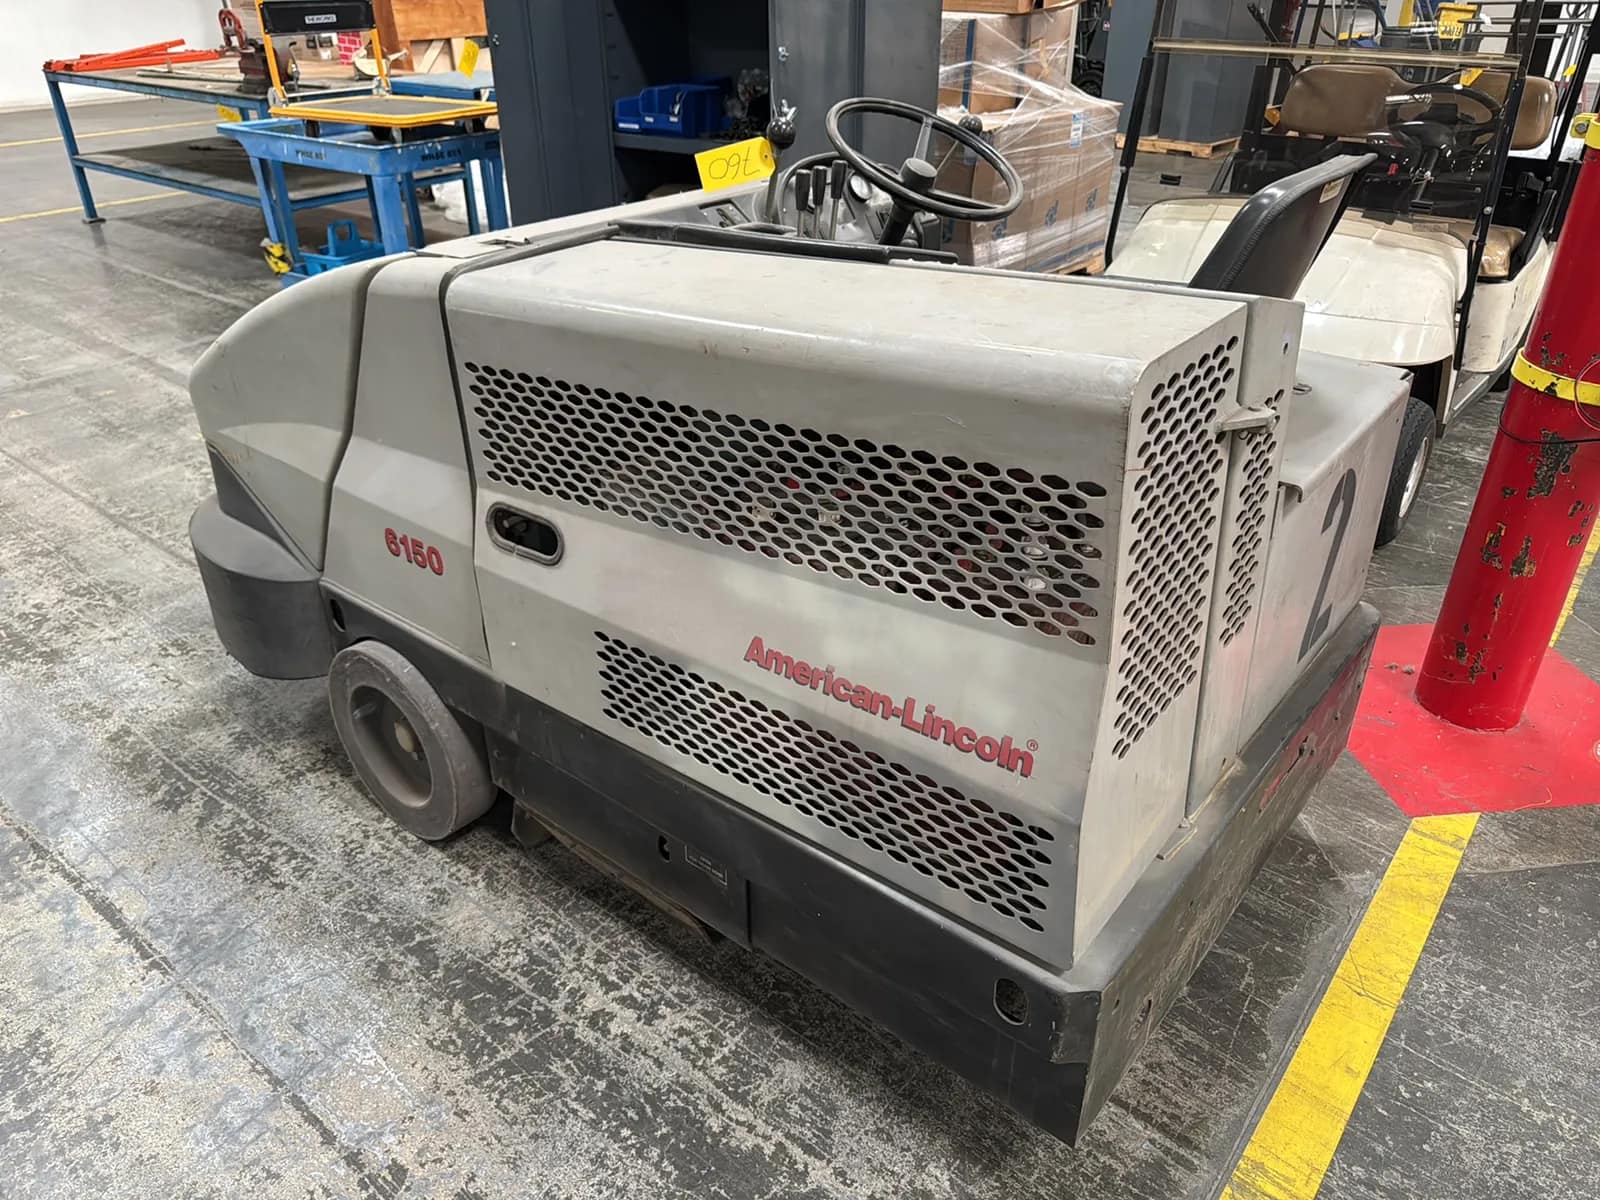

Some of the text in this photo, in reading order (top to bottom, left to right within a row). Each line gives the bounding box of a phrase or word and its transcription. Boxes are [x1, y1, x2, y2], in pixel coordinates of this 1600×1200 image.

[709, 146, 760, 180] 760
[384, 527, 444, 576] 6150
[1297, 468, 1356, 664] 2
